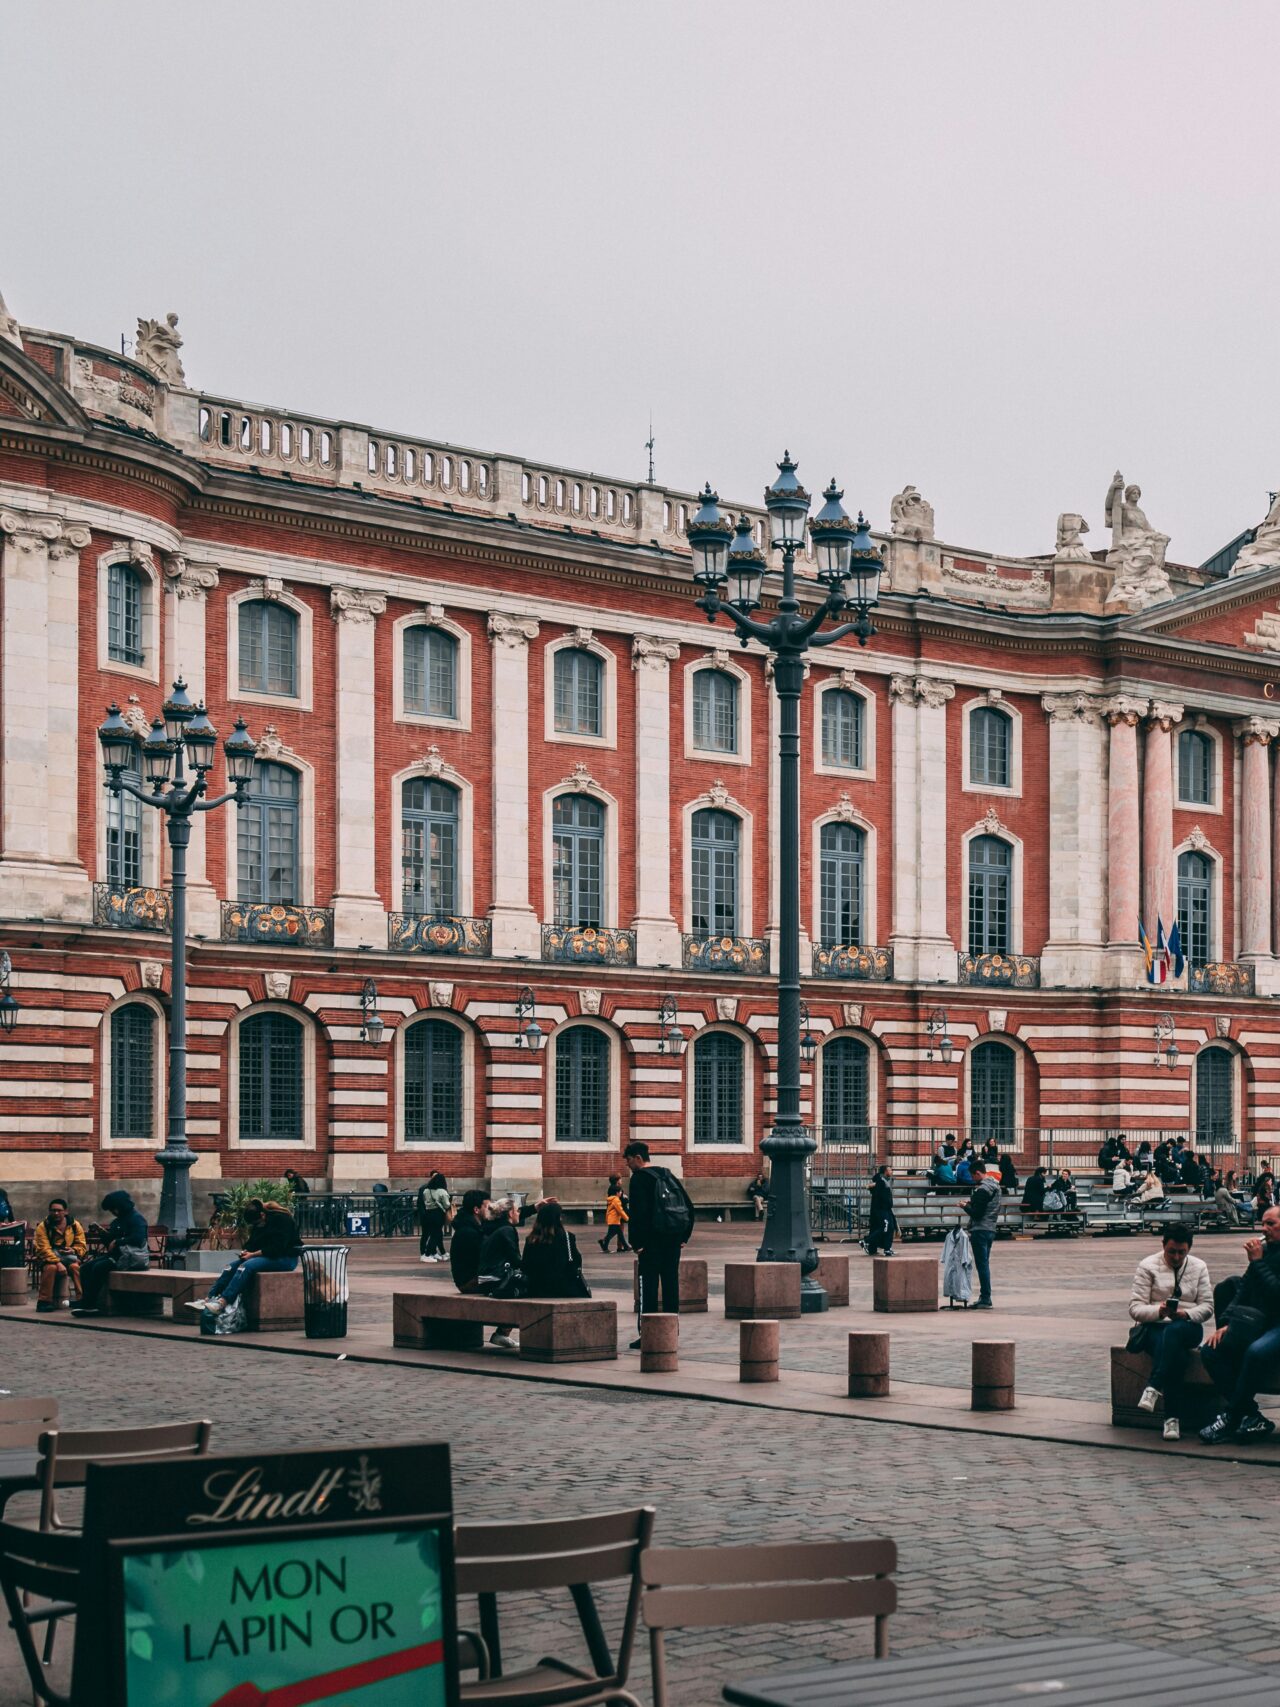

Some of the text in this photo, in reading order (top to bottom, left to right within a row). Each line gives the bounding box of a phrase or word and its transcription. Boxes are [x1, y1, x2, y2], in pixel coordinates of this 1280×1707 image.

[351, 1217, 362, 1231] P
[185, 1466, 346, 1525] Lindt
[229, 1555, 347, 1605] MON
[183, 1601, 397, 1663] LAPIN OR
